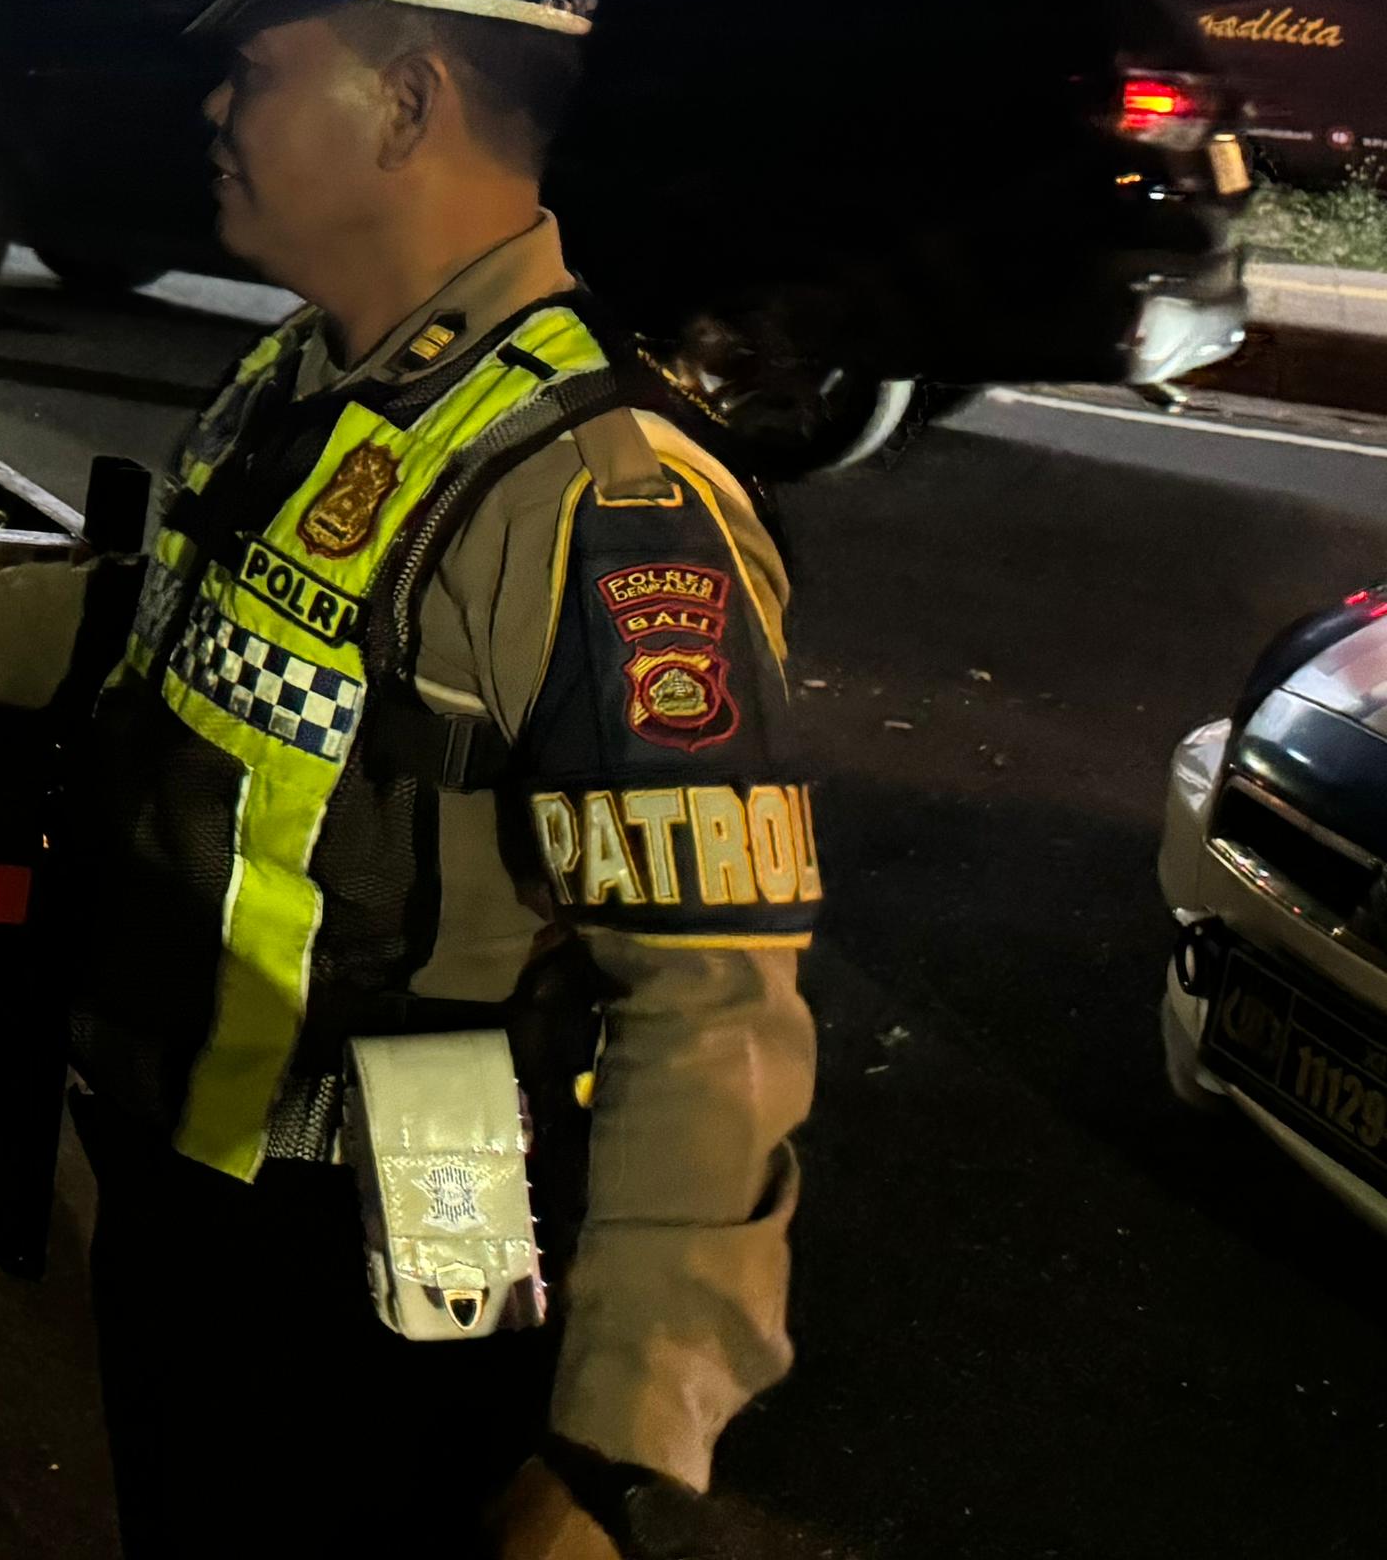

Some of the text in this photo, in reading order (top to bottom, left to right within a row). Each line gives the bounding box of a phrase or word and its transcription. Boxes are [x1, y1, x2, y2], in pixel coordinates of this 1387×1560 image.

[245, 546, 357, 634] POLRI
[627, 610, 710, 632] BALI
[531, 784, 823, 906] PATROL
